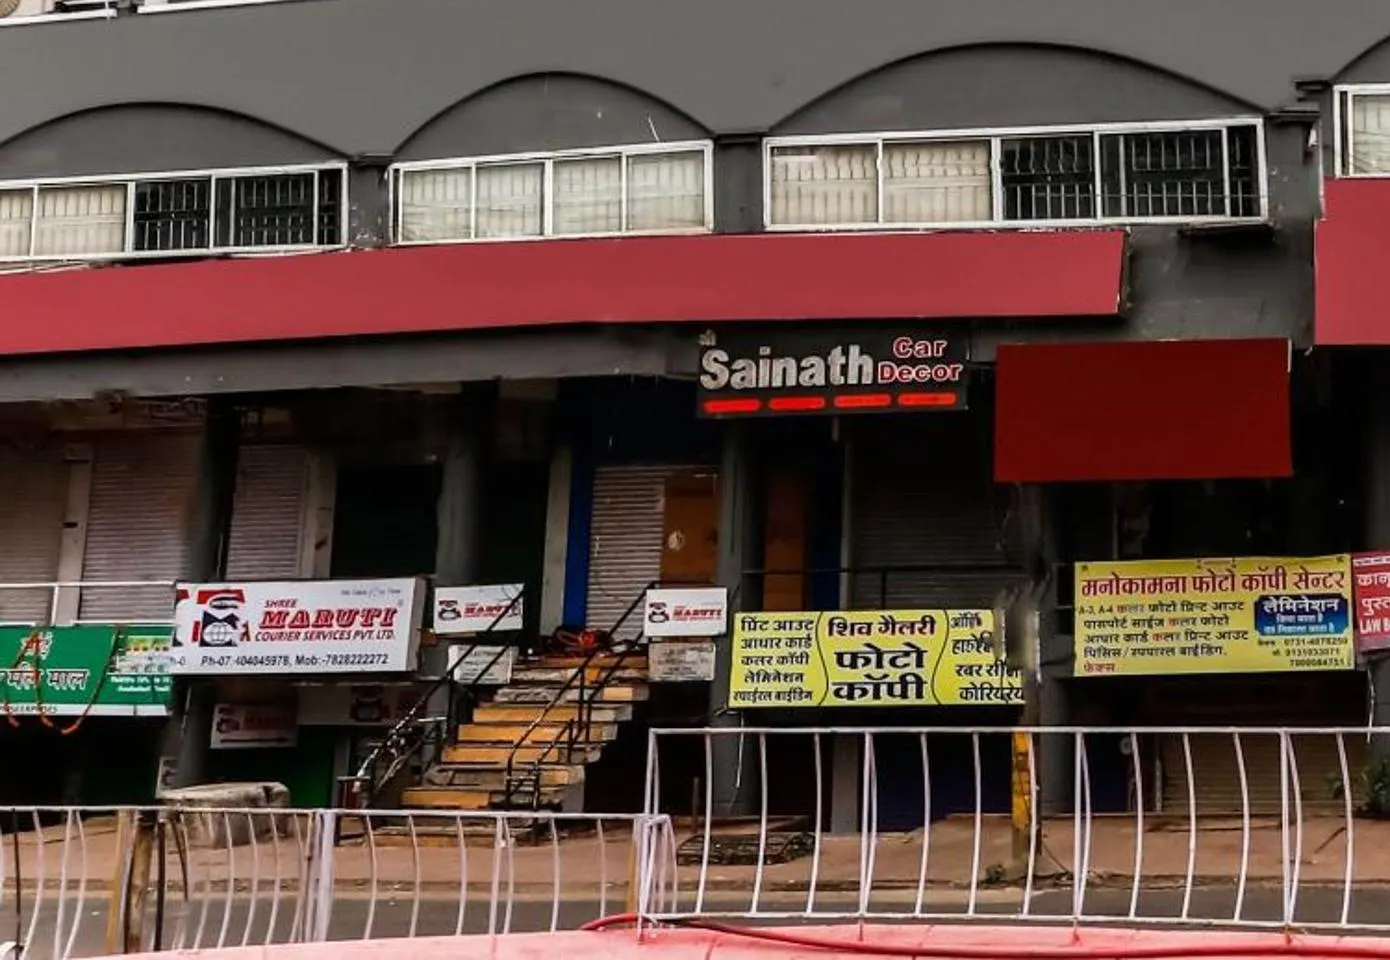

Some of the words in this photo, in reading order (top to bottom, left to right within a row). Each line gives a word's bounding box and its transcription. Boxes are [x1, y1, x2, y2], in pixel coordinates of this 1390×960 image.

[893, 336, 947, 358] Car
[700, 344, 873, 390] Sainath
[878, 361, 963, 383] Decor
[1081, 572, 1187, 596] मनोकामना
[1192, 569, 1235, 592] फोटो
[1241, 565, 1288, 592] कॉपी
[1292, 565, 1345, 589] सेन्टर
[265, 599, 298, 609] SHREE
[464, 606, 516, 614] MARU
[673, 608, 722, 617] MARUTI
[1263, 596, 1340, 613] लेमिनेशन
[259, 607, 398, 629] MARUTI
[828, 617, 875, 637] शिव
[878, 615, 936, 636] गैलरी
[1360, 617, 1381, 634] LAW
[255, 631, 300, 642] COURIER
[303, 630, 352, 642] SERVICES
[741, 655, 773, 666] कलर
[834, 642, 928, 670] फोटो
[955, 664, 983, 677] रबर
[831, 672, 928, 702] कॉपी
